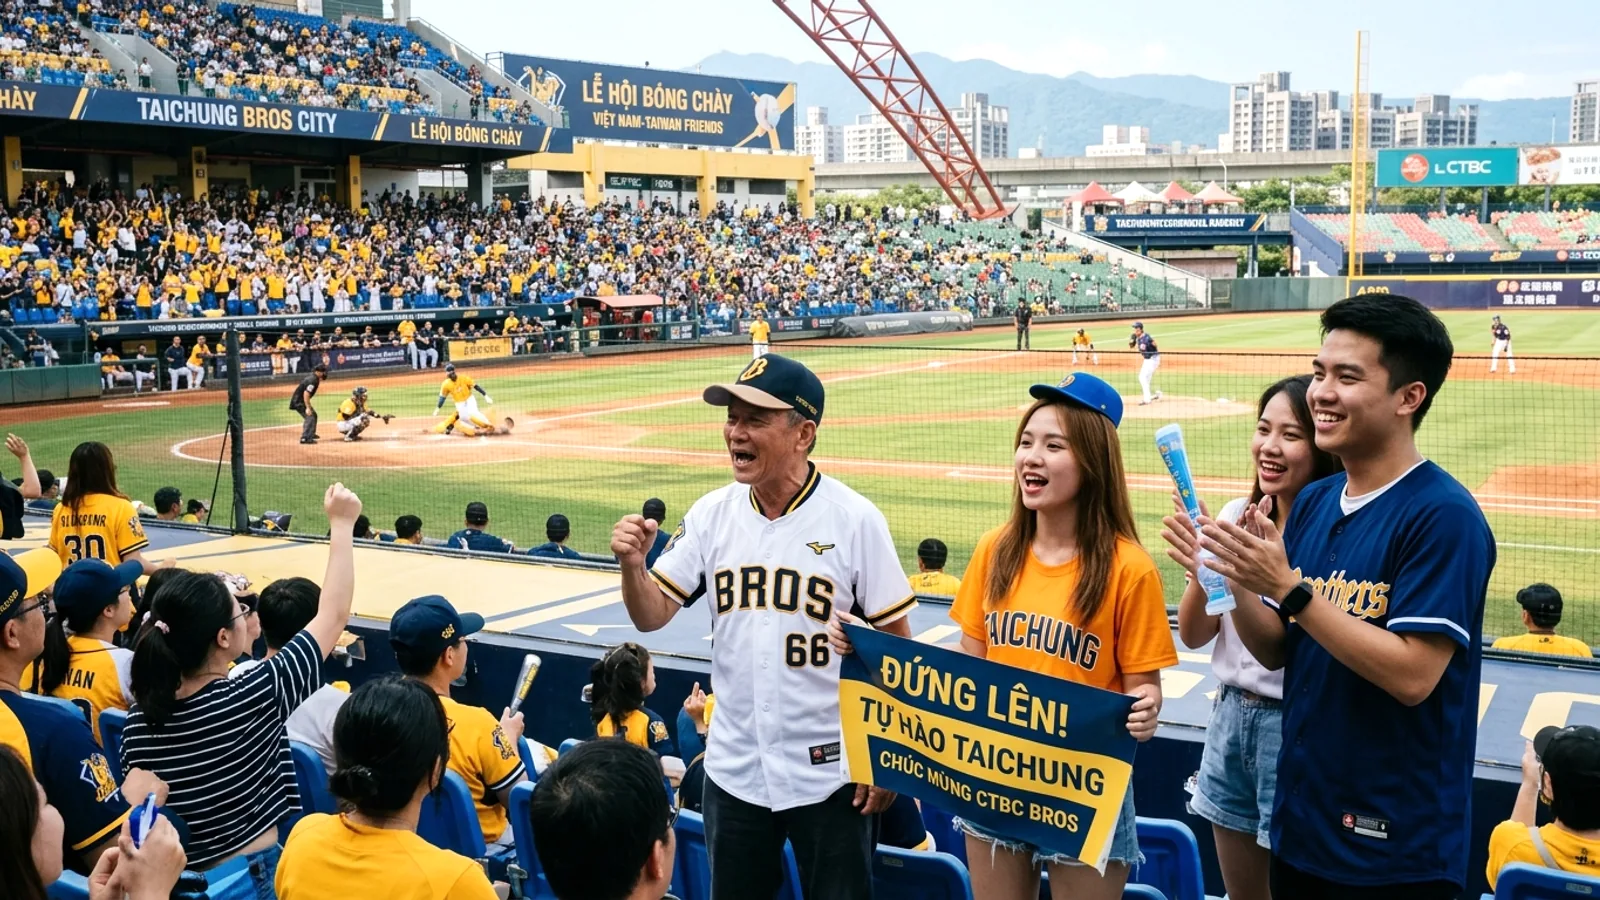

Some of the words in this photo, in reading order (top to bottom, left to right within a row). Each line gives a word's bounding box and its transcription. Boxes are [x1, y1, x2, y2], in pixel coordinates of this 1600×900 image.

[137, 97, 237, 127] TAICHUNG
[243, 106, 293, 131] BROS
[297, 110, 338, 134] CITY
[608, 79, 637, 111] HỘI
[643, 82, 688, 111] BÓNG
[692, 87, 733, 114] CHÀY
[684, 118, 724, 134] FRIENDS
[65, 534, 105, 565] 30
[714, 565, 834, 624] BROS
[1289, 566, 1391, 623] others
[785, 632, 830, 668] 66
[880, 655, 976, 712] ĐỨNG
[987, 682, 1069, 738] LÊN!
[860, 696, 894, 733] TỰ
[900, 712, 945, 753] HÀO
[952, 733, 1105, 796] TAICHUNG
[880, 750, 924, 779] CHÚC
[976, 789, 1024, 817] CTBC
[1029, 802, 1079, 833] BROS
